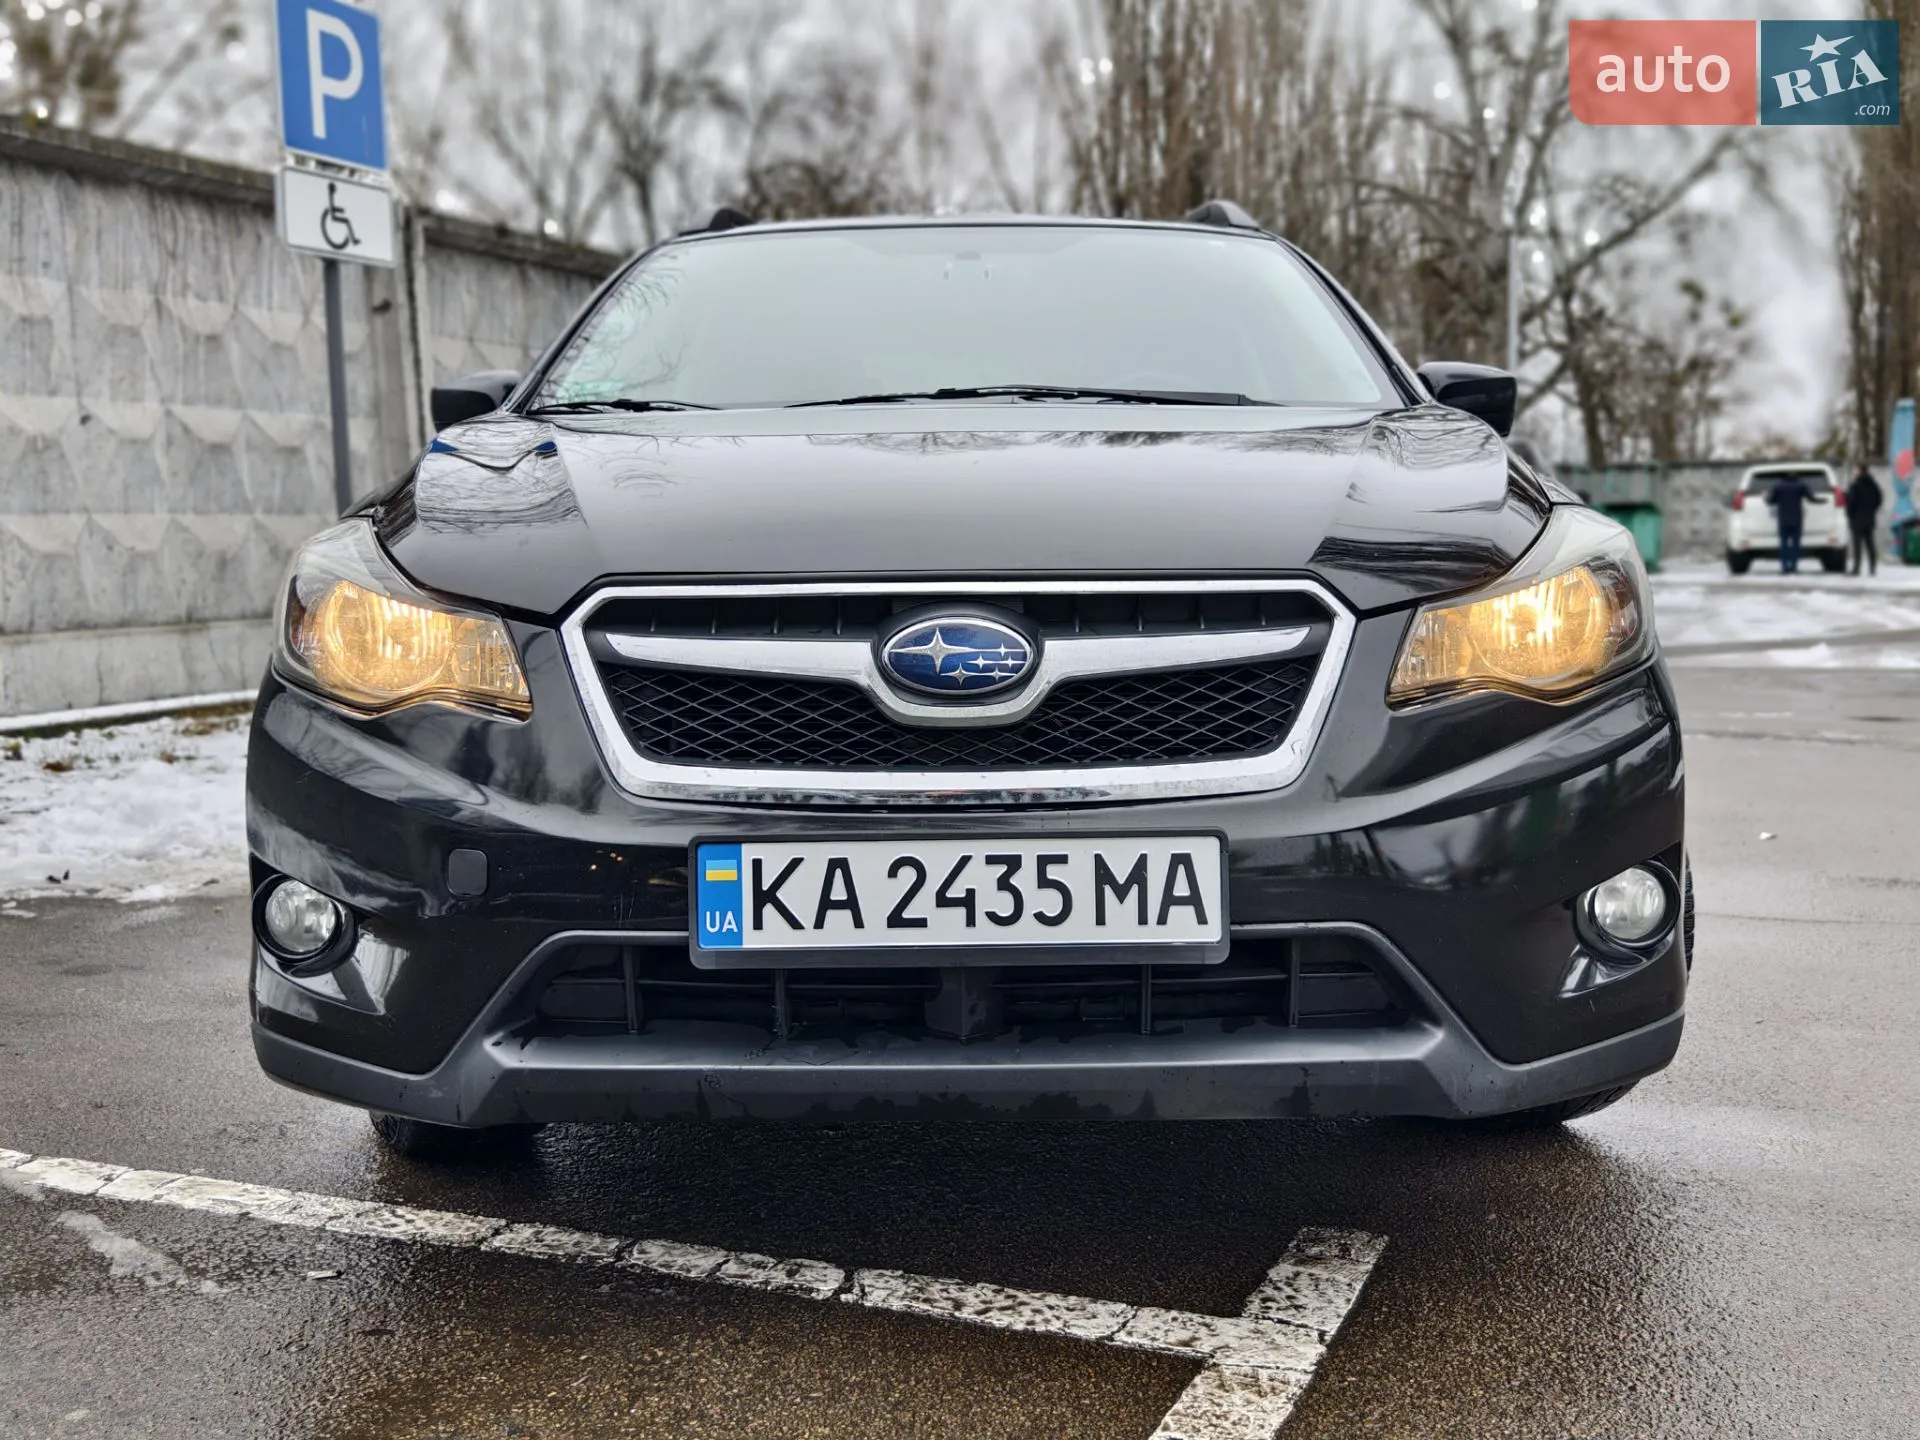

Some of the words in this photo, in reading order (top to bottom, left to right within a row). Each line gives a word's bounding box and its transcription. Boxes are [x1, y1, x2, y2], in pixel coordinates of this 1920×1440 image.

[305, 7, 364, 140] P
[705, 910, 739, 934] UA
[752, 855, 866, 931] KA
[886, 853, 1073, 929] 2435
[1094, 852, 1209, 927] MA
